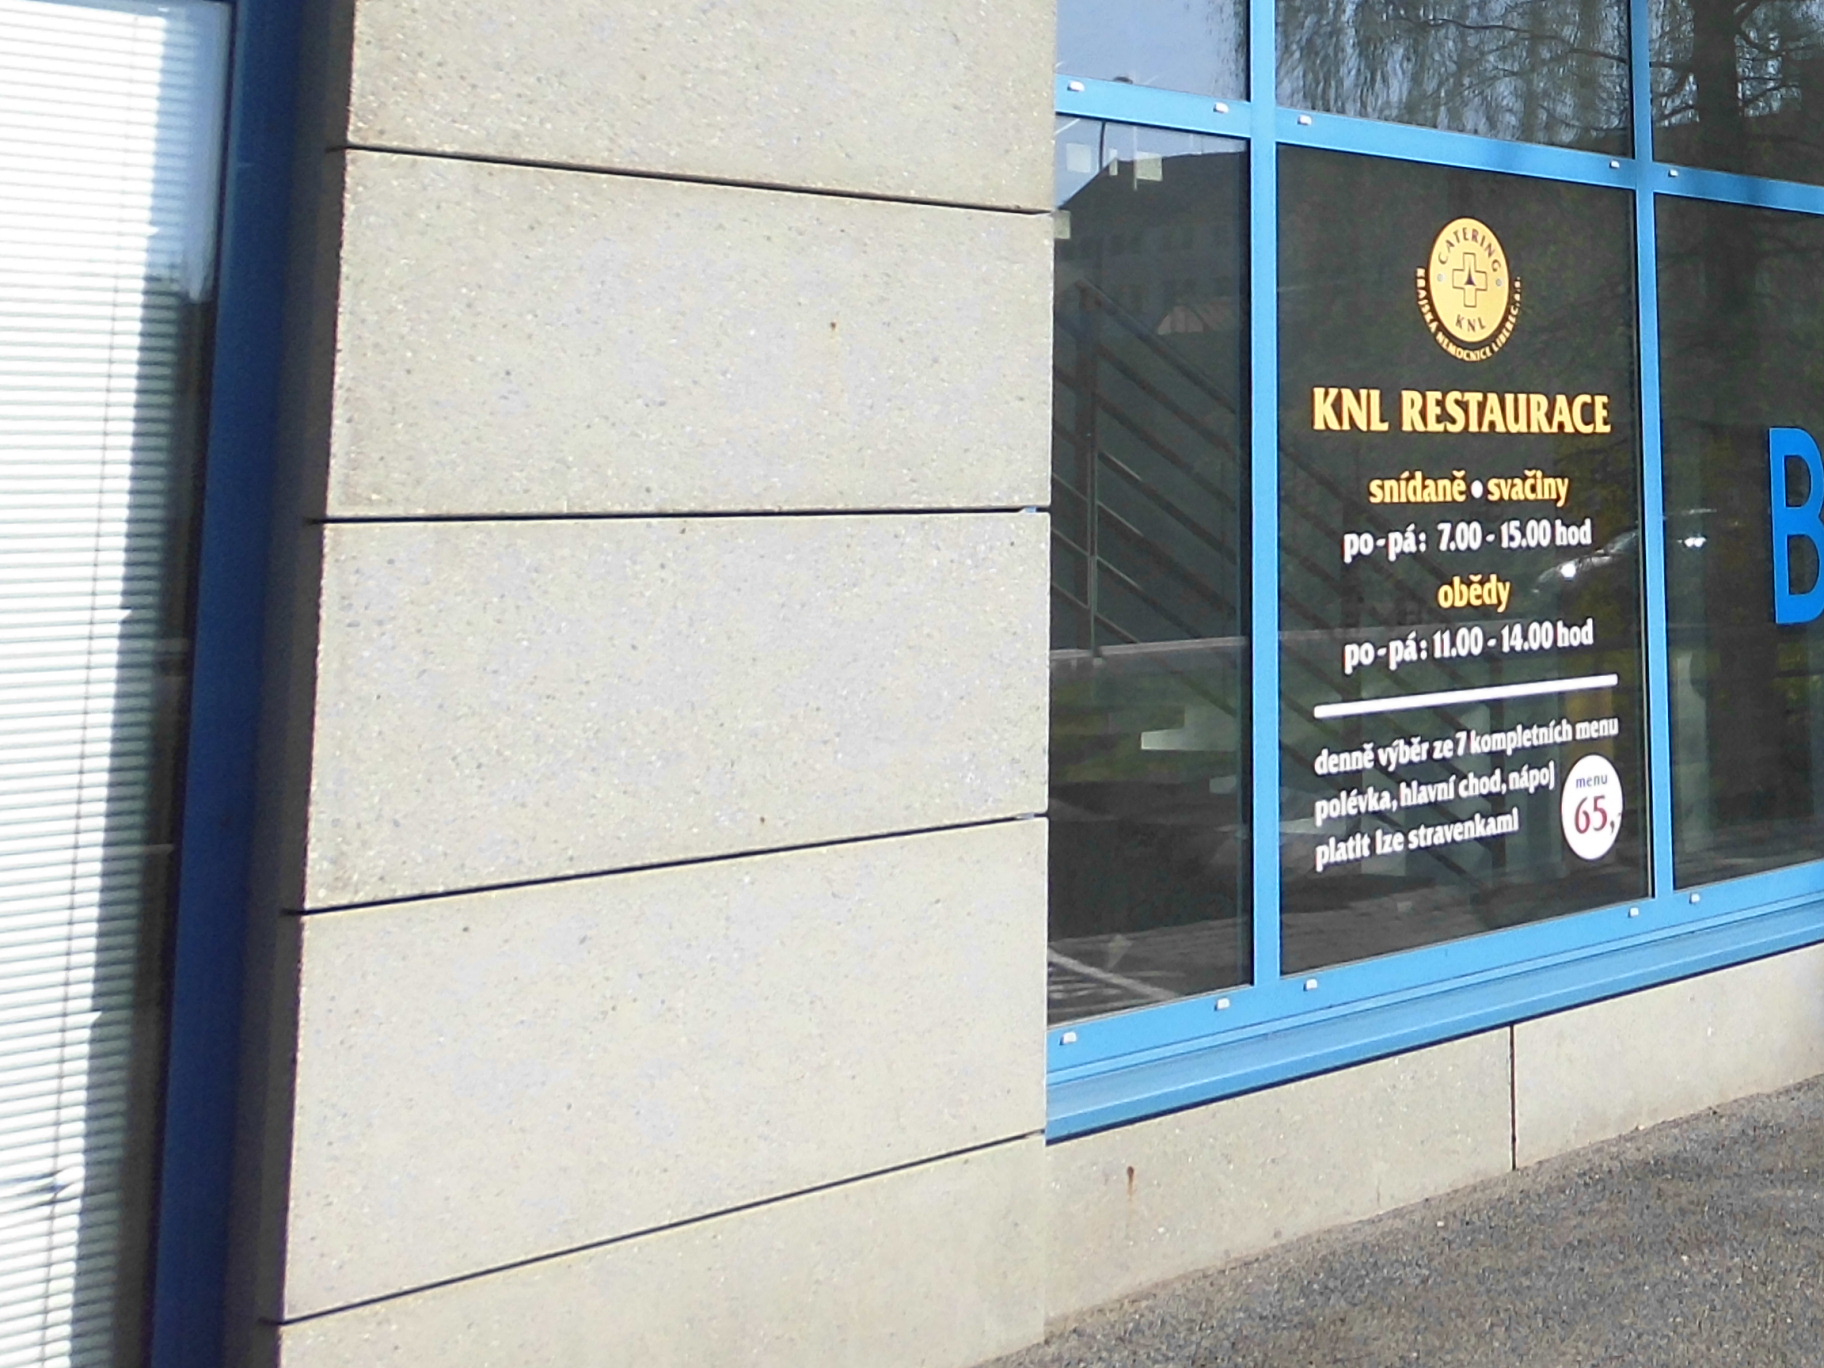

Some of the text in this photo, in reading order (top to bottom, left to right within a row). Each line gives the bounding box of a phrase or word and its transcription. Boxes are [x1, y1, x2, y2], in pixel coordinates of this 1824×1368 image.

[1438, 227, 1502, 273] CATERING
[1455, 314, 1487, 334] KNL
[1436, 331, 1493, 362] NEMOCNICE
[1312, 386, 1611, 434] KNL RESTAURACE
[1368, 469, 1569, 507] snídaně svačiny
[1437, 522, 1482, 552] 7.00
[1500, 519, 1551, 549] 15.00
[1554, 517, 1592, 546] hod
[1437, 574, 1511, 612] obědy
[1433, 627, 1484, 659] 11.00
[1501, 621, 1553, 653] 14.00
[1555, 618, 1594, 648] hod
[1314, 717, 1619, 776] denně výběr ze 7 kompletních menu
[1315, 760, 1555, 827] polévka, hlavní chod, nápoj
[1576, 774, 1608, 790] menu
[1315, 807, 1519, 872] platit lze stravenkami
